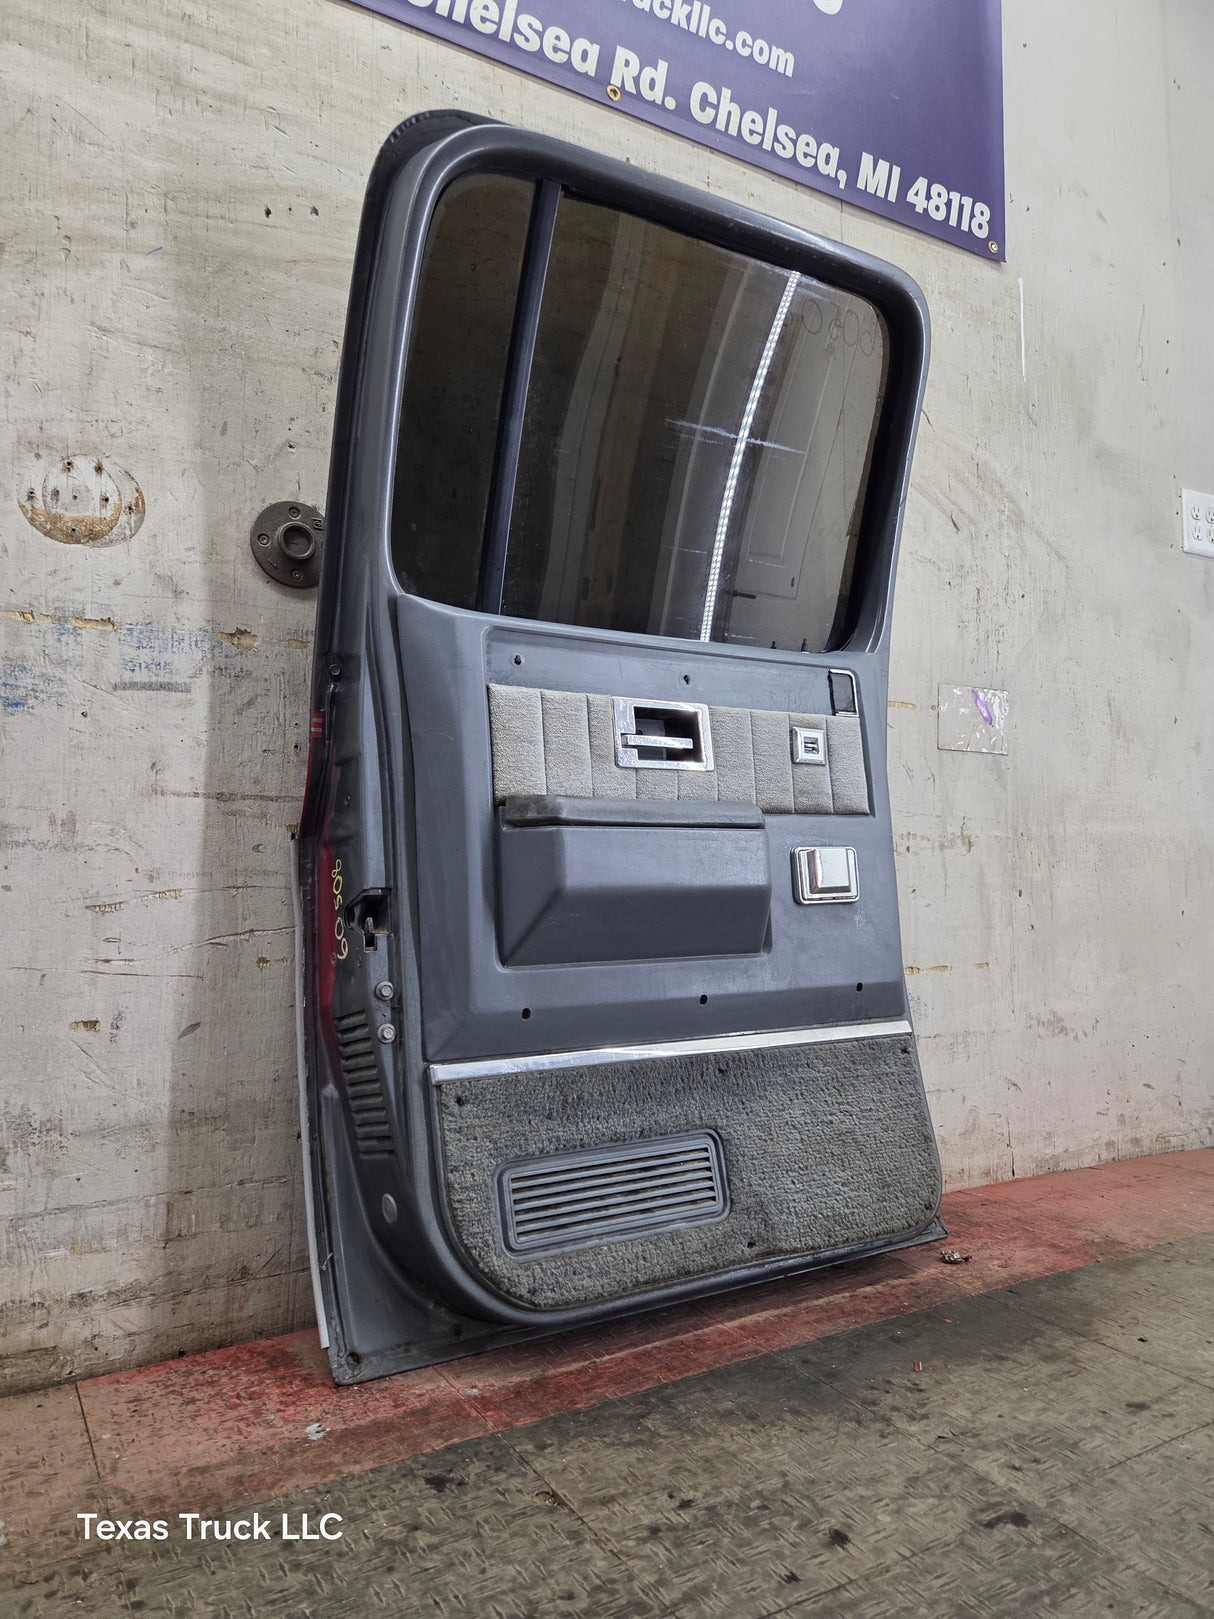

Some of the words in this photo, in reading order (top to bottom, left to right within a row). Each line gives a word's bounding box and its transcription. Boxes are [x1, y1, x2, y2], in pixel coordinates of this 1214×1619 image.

[619, 0, 796, 78] uckllc.com
[407, 0, 600, 78] elsea
[610, 45, 677, 110] Rd.
[690, 81, 847, 190] Chelsea,
[856, 151, 901, 203] MI
[906, 176, 991, 239] 48118
